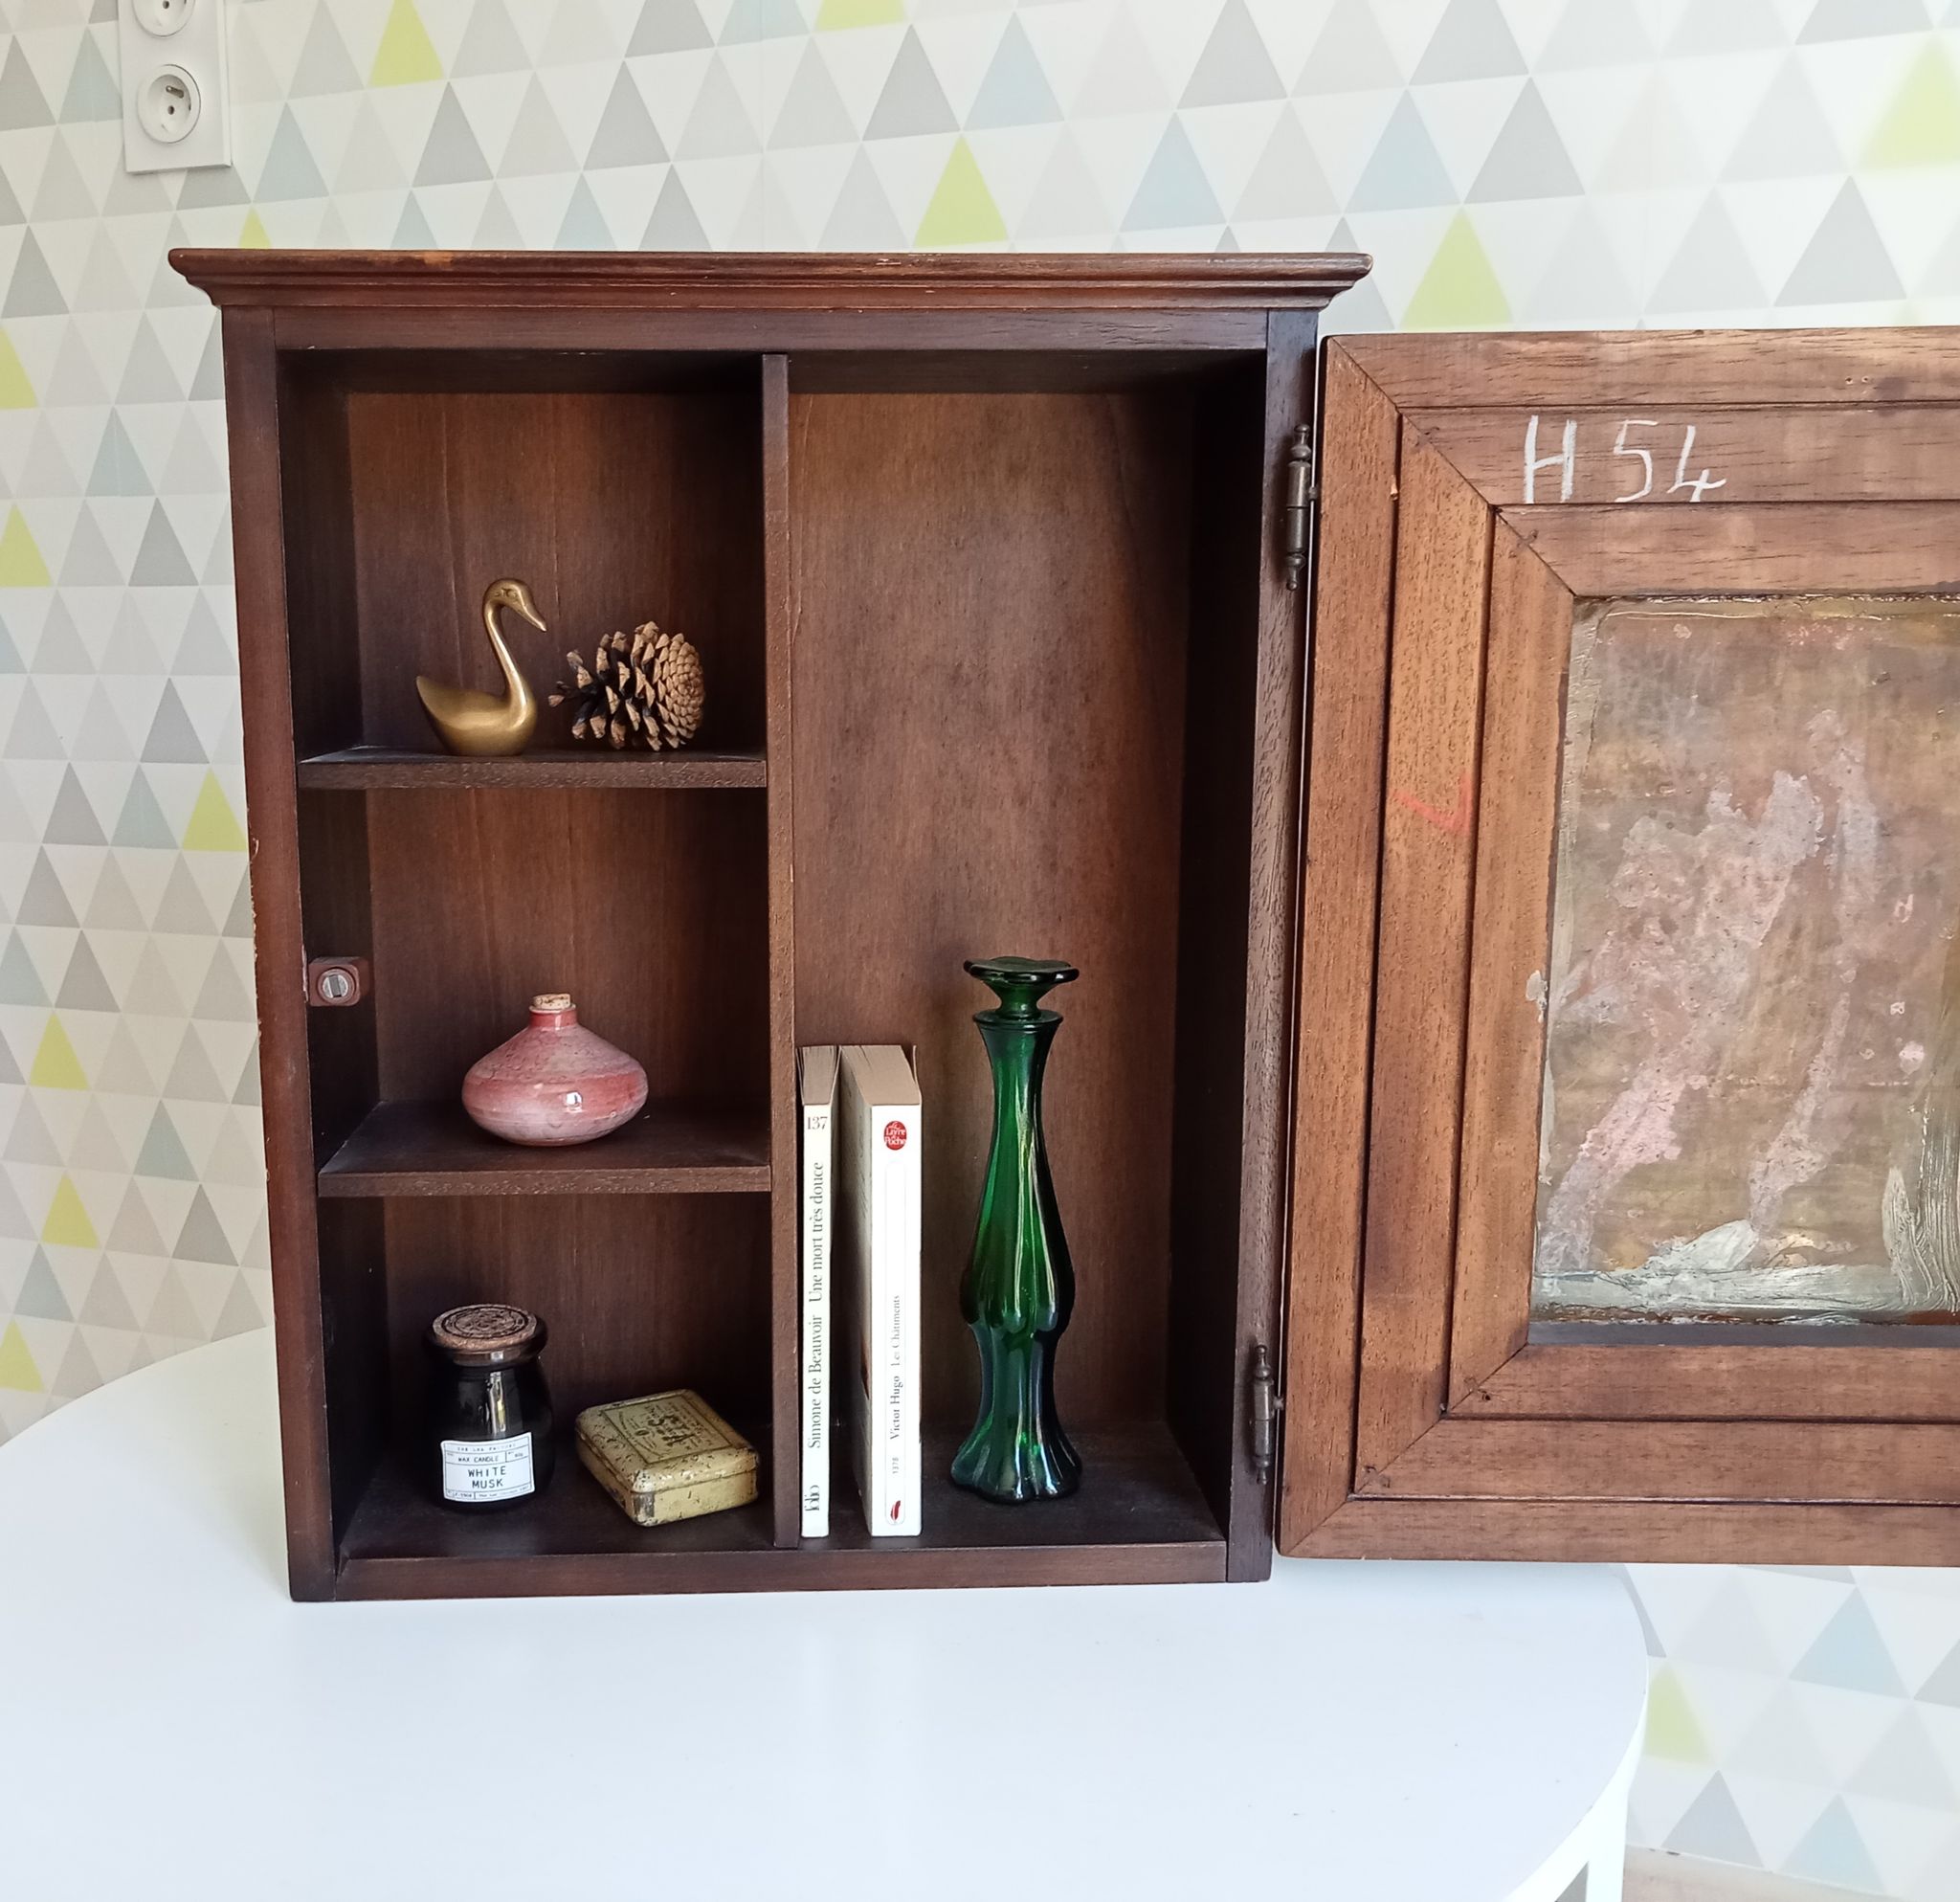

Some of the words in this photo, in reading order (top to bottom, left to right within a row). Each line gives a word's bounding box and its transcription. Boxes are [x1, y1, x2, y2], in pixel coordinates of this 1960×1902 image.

[1524, 414, 1577, 503] H
[1614, 419, 1726, 503] 54
[807, 1116, 828, 1130] 137
[809, 1162, 823, 1204] douce
[809, 1208, 823, 1232] très
[813, 1238, 823, 1269] mort
[808, 1274, 822, 1302] Une
[890, 1295, 901, 1349] Châtiments
[808, 1315, 822, 1373] Beauvoir
[808, 1377, 821, 1394] de
[890, 1376, 903, 1404] Hugo
[808, 1399, 821, 1448] Simone
[890, 1409, 901, 1440] Victor
[468, 1466, 506, 1477] WHITE
[472, 1478, 503, 1488] MUSK
[804, 1485, 820, 1511] folio
